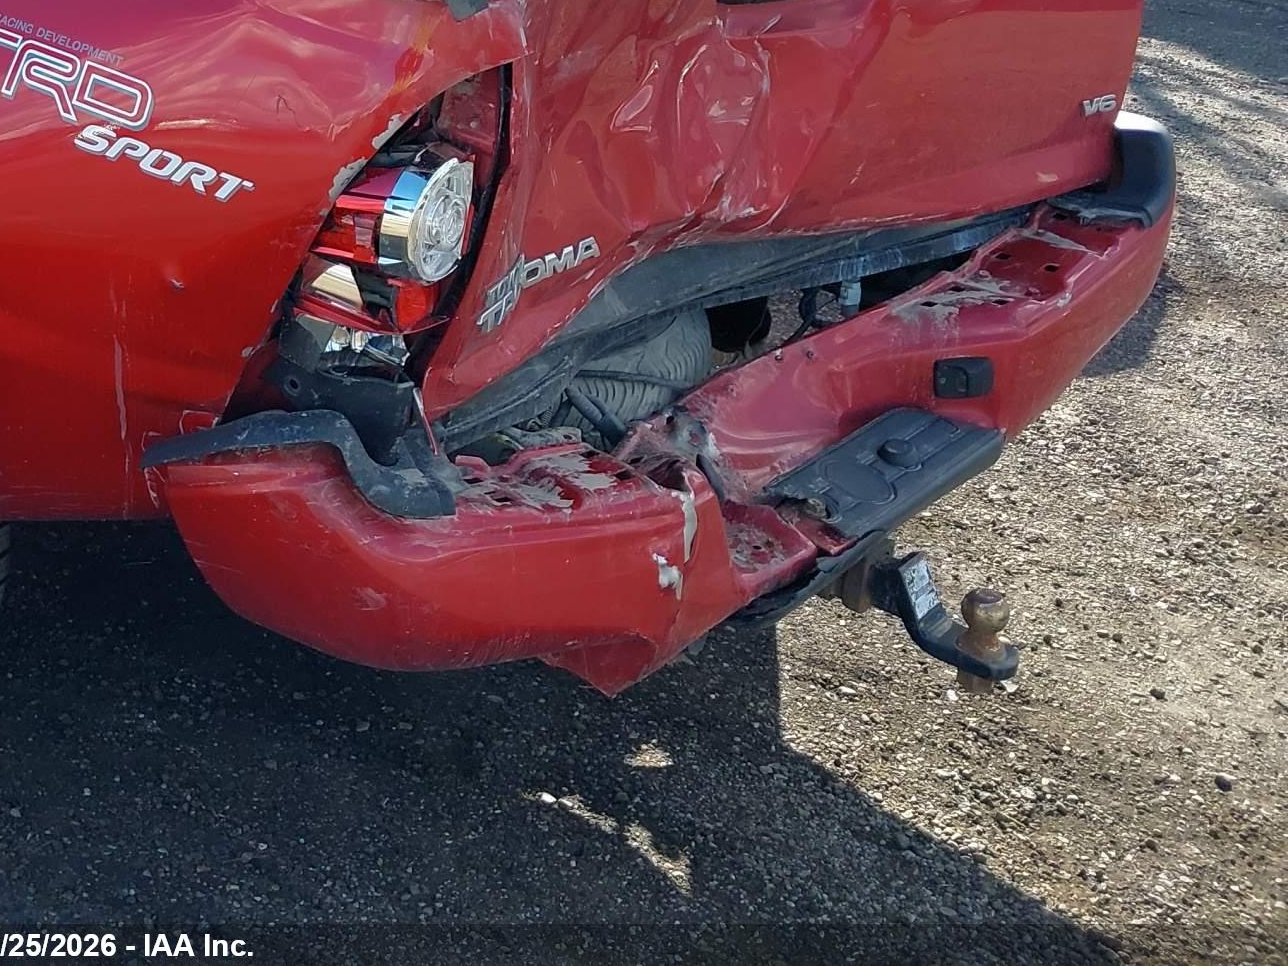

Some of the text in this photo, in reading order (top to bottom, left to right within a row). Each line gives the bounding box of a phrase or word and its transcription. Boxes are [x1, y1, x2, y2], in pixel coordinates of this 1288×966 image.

[35, 27, 124, 67] DEVELOPMENT
[1082, 93, 1117, 117] V6
[73, 124, 255, 202] SPORT
